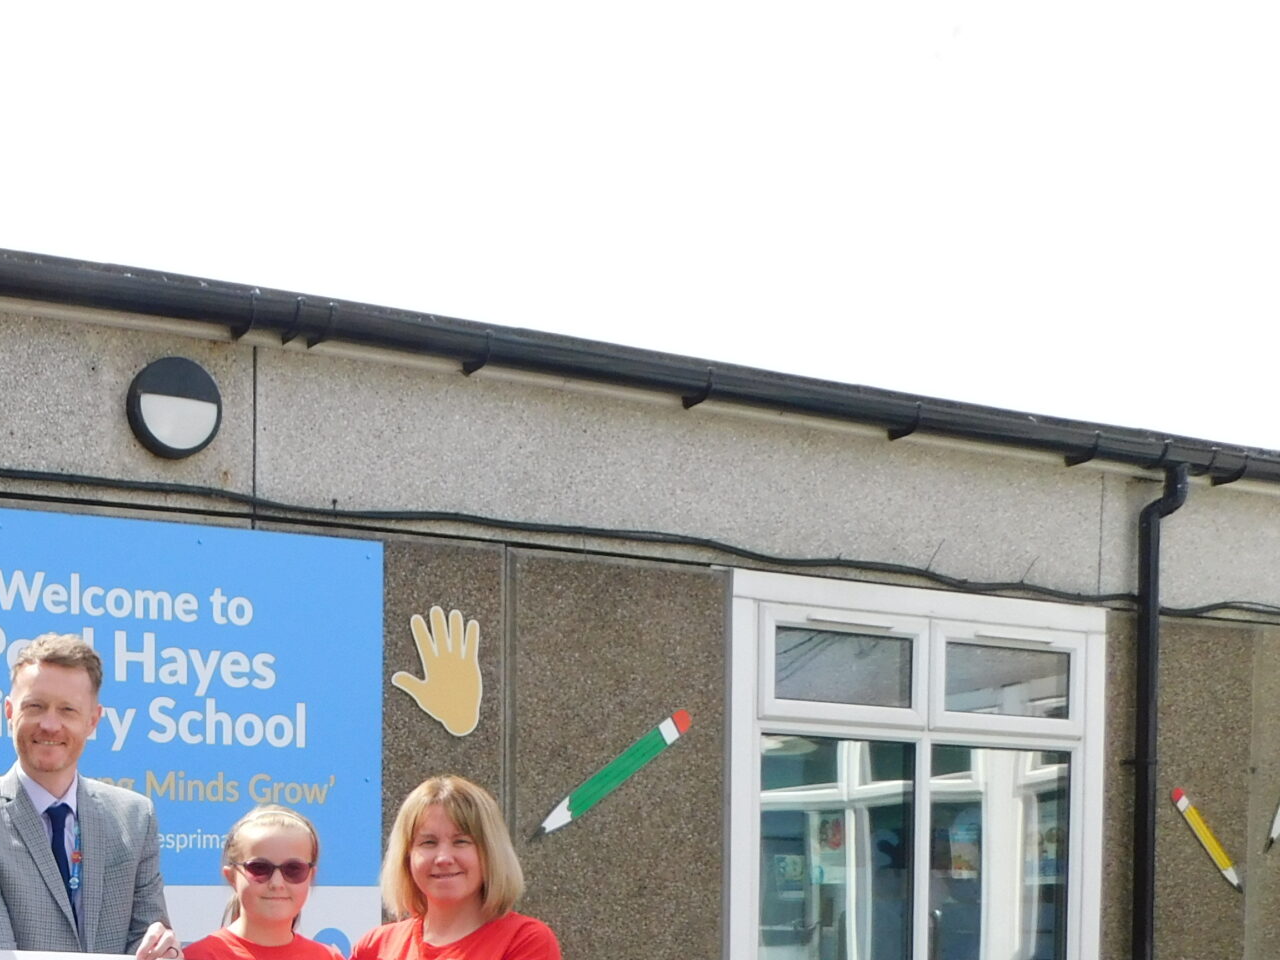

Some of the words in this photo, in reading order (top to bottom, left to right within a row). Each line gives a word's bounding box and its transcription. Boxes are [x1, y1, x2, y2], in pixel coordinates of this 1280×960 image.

[211, 587, 254, 626] to
[114, 629, 276, 697] Hayes
[147, 696, 307, 748] School
[145, 770, 240, 803] Minds
[248, 773, 336, 804] Grow’
